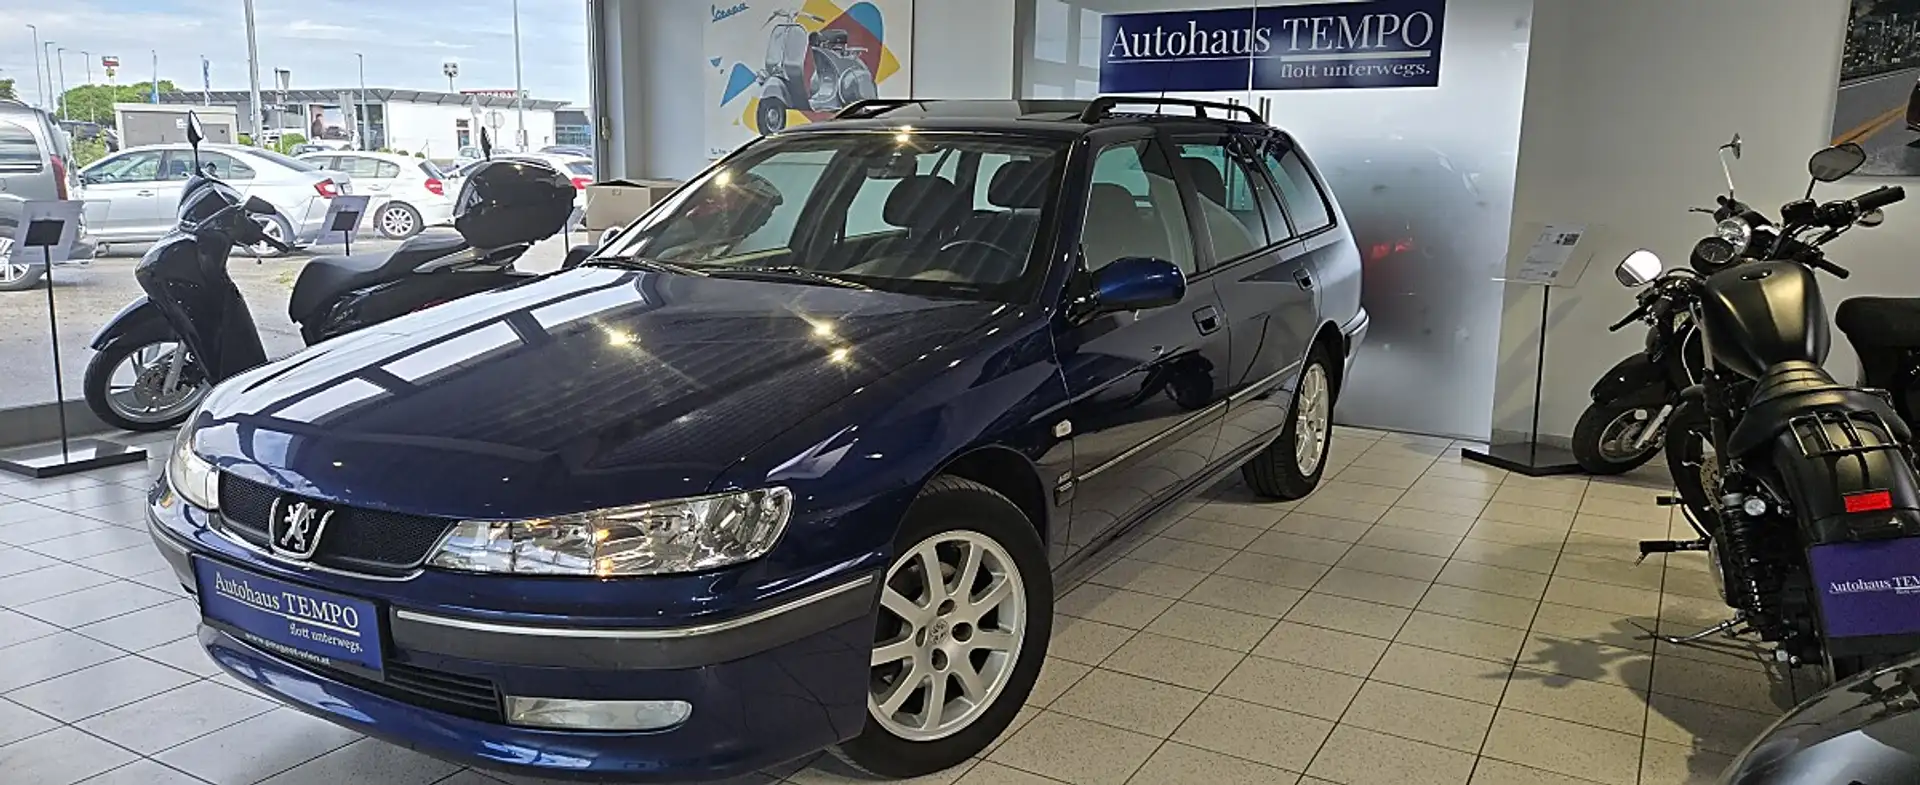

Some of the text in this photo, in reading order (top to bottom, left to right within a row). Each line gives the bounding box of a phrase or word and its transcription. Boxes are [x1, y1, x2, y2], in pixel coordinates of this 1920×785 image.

[1108, 11, 1434, 58] Autohaus TEMPO
[1281, 60, 1431, 79] flott unterwegs.
[215, 571, 358, 628] Autohaus TEMPO
[1828, 578, 1891, 594] Autohaus
[289, 622, 363, 653] flott unterwegs.
